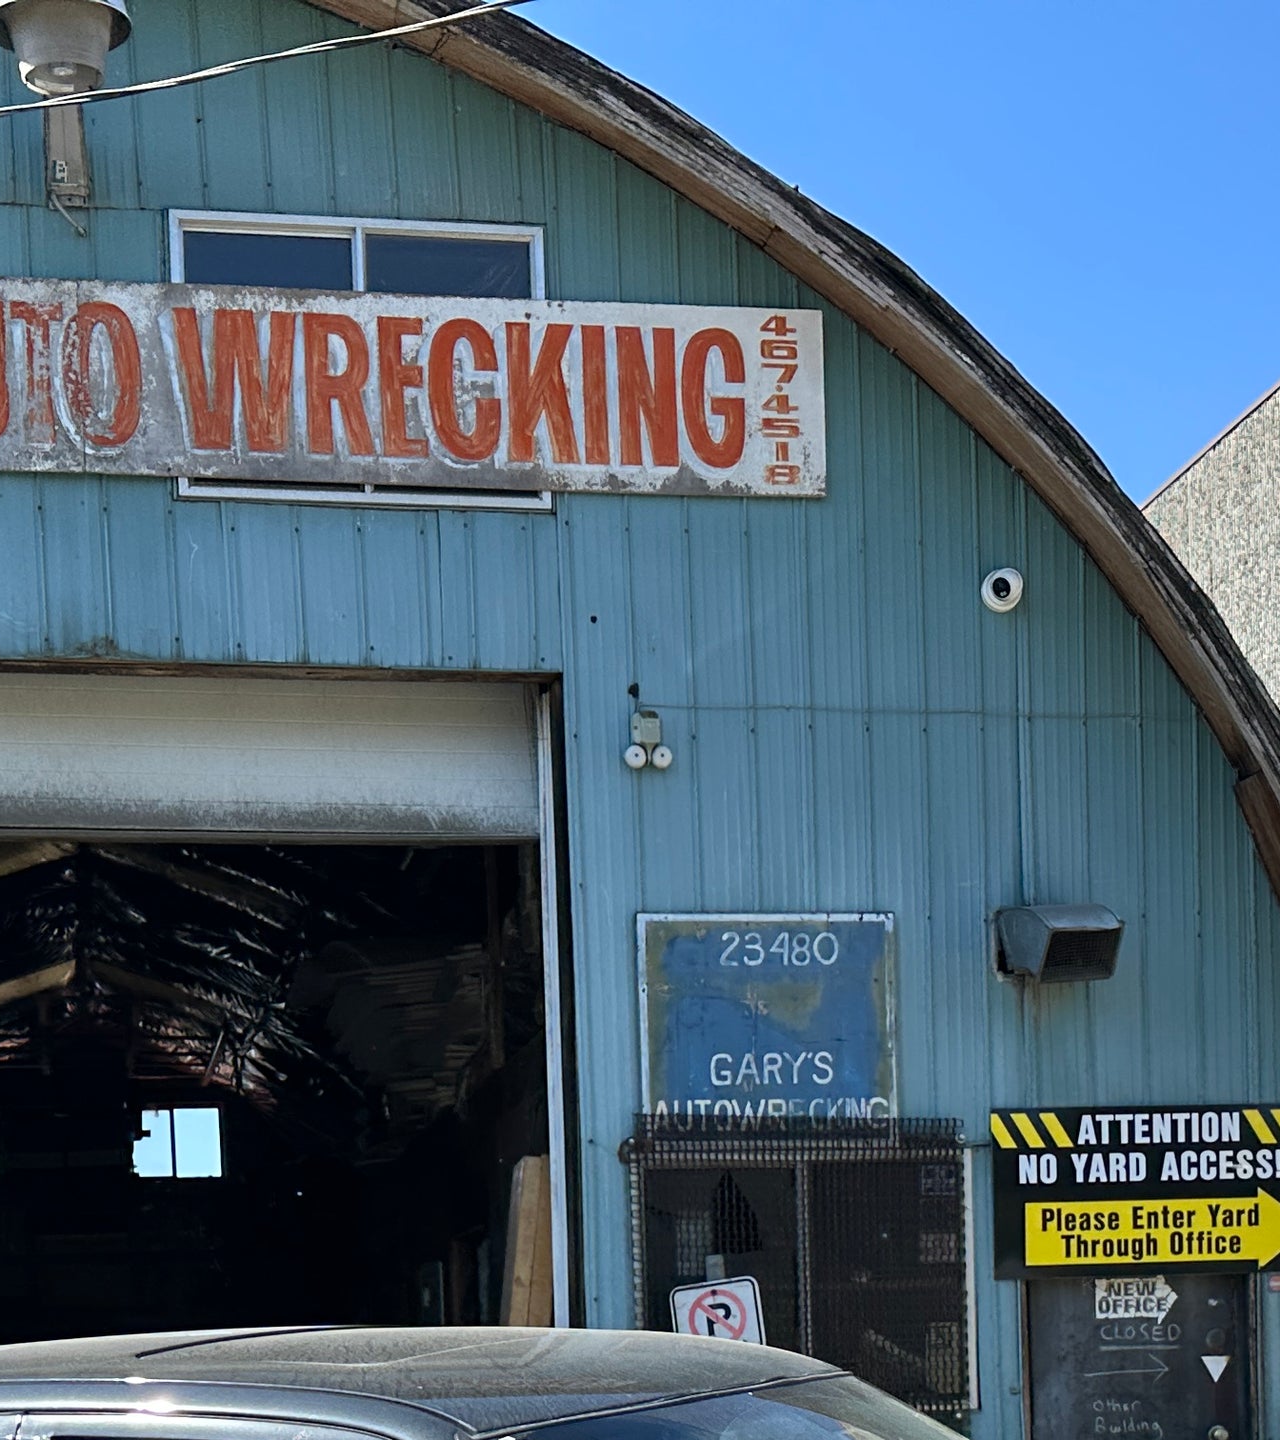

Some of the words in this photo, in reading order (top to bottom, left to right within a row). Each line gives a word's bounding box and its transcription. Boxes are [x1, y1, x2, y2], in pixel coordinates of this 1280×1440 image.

[171, 306, 746, 469] WRECKING
[719, 931, 839, 966] 23480
[709, 1051, 834, 1087] GARY'S
[1076, 1111, 1240, 1145] ATTENTION
[1018, 1153, 1058, 1184] NO
[1070, 1152, 1147, 1183] YARD
[1040, 1208, 1120, 1232] Please
[1131, 1206, 1196, 1230] Enter
[1207, 1203, 1260, 1227] Yard
[1060, 1233, 1159, 1261] Through
[1169, 1231, 1242, 1255] Office
[1107, 1281, 1157, 1297] NEW
[1097, 1298, 1168, 1314] OFFICE
[1100, 1324, 1182, 1341] CLOSED
[1095, 1416, 1163, 1440] Building
